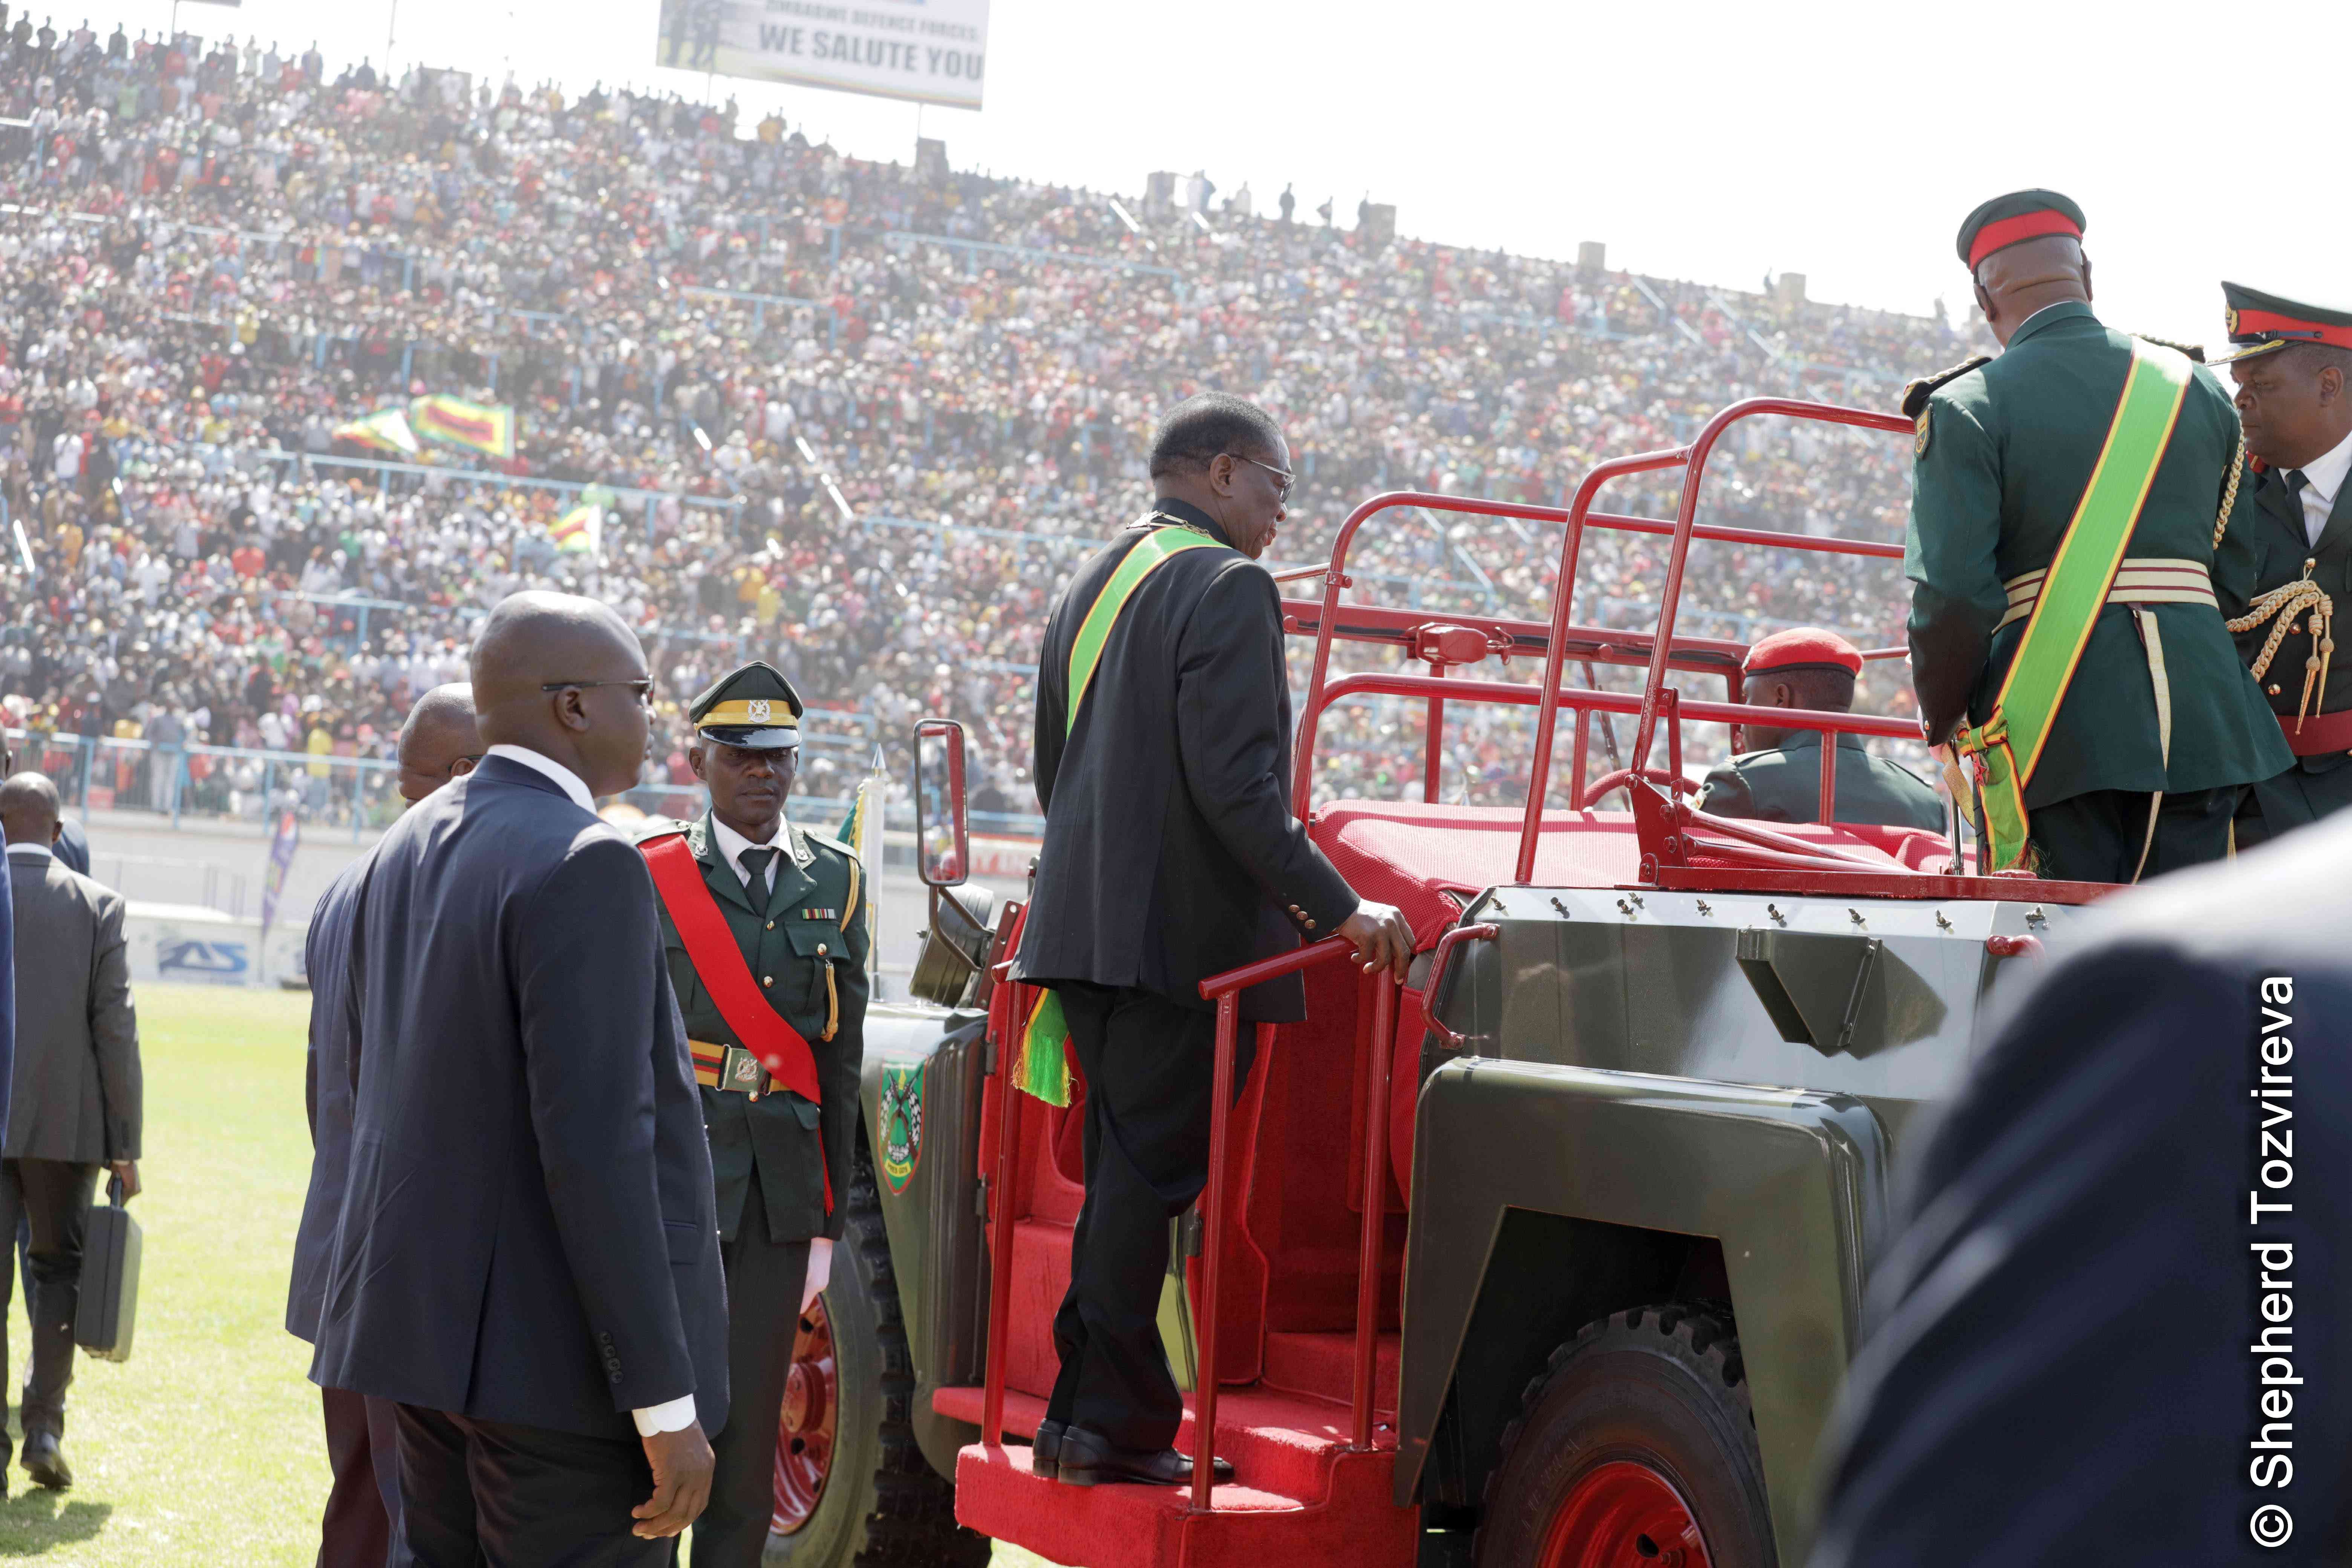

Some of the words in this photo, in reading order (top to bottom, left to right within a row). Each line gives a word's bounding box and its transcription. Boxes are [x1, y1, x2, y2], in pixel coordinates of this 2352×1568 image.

[758, 21, 804, 55] WE
[812, 31, 918, 72] SALUTE
[926, 46, 983, 80] YOU
